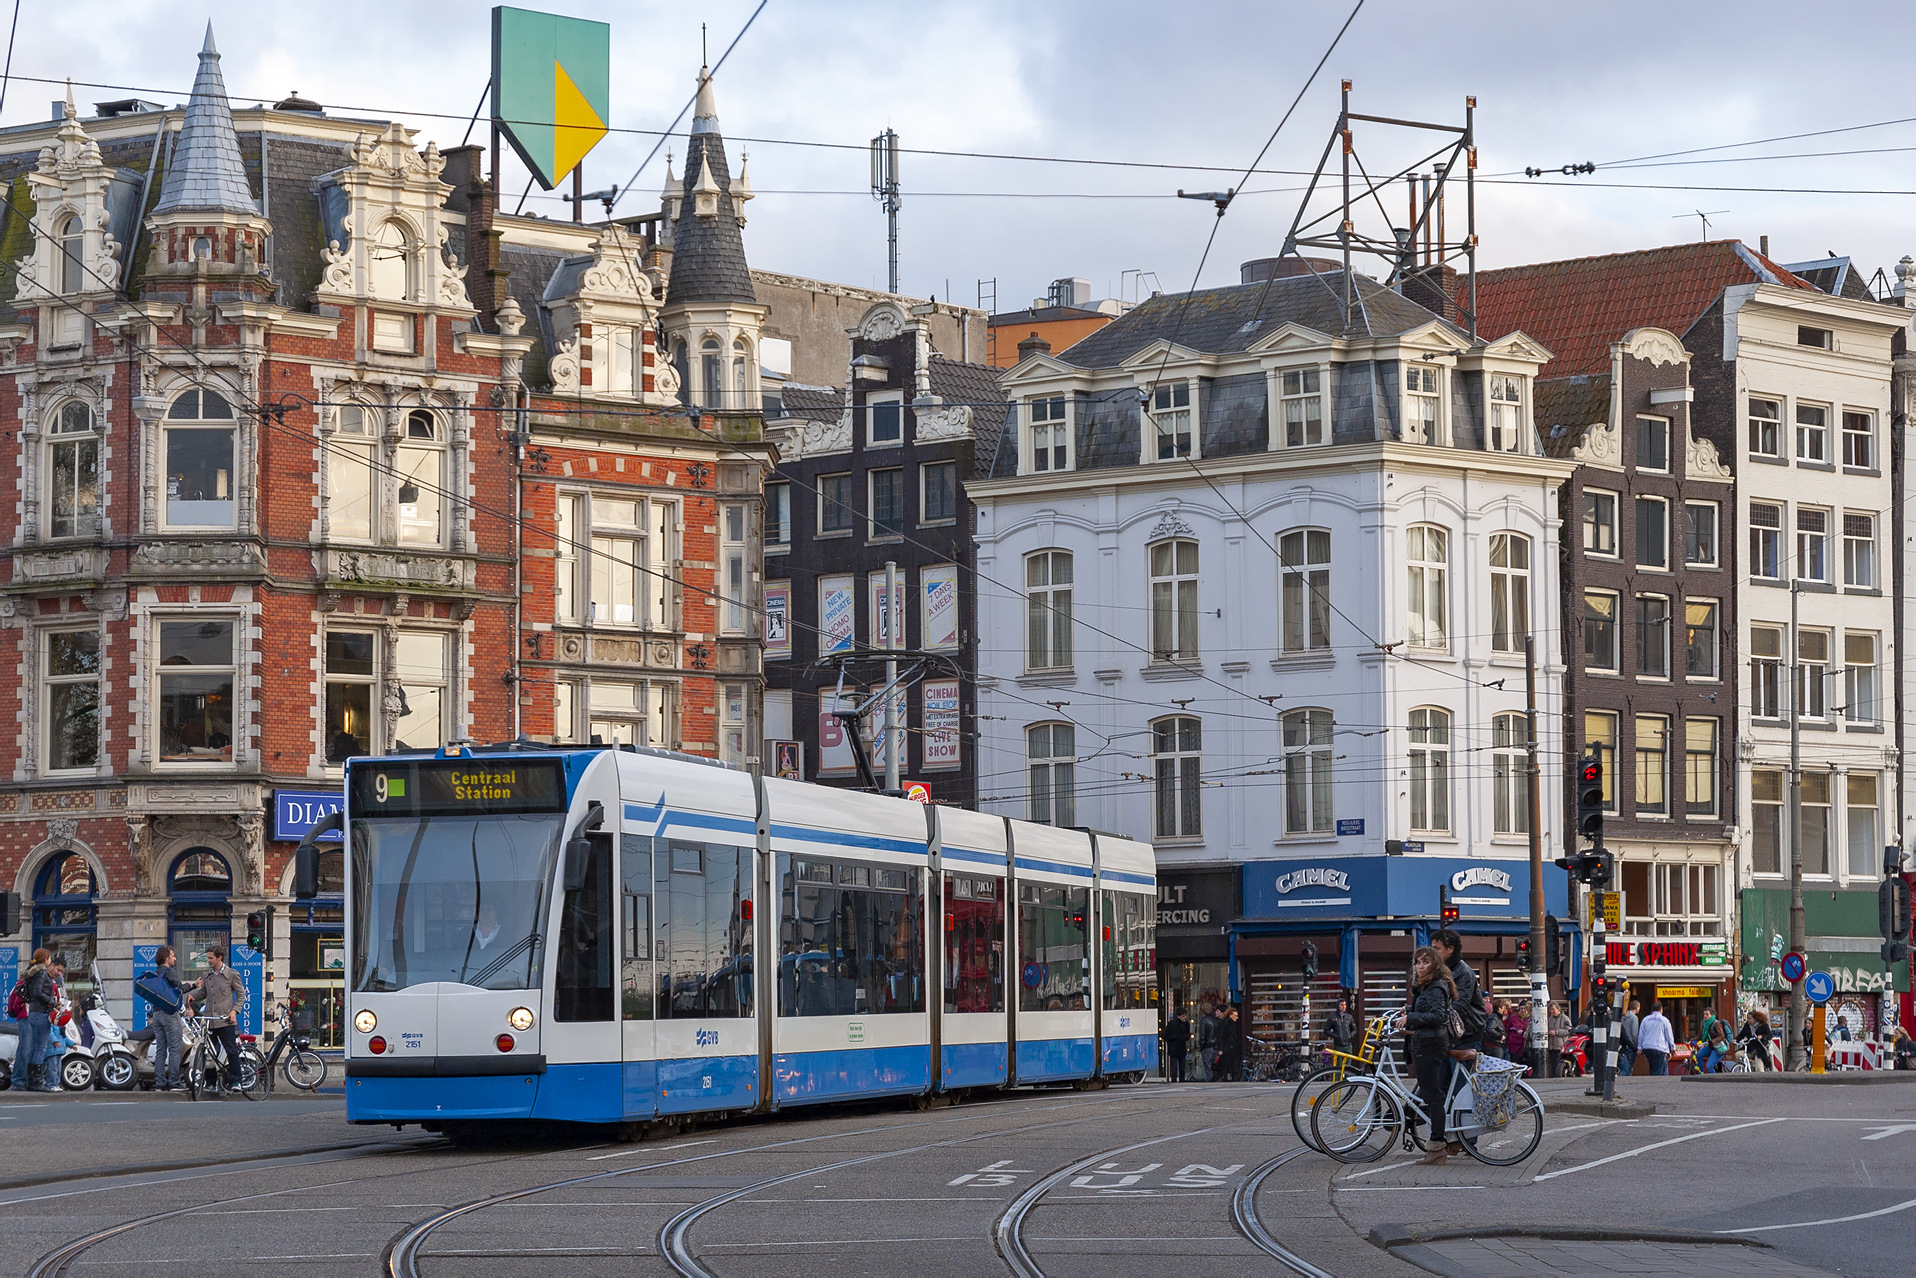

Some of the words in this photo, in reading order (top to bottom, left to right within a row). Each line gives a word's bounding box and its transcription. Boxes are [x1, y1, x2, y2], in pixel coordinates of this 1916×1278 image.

[827, 590, 844, 608] NEW
[934, 581, 952, 599] DAYS
[766, 599, 785, 607] CINEMA
[825, 596, 852, 622] PRIVATE
[933, 592, 954, 612] WEEK
[828, 614, 850, 634] HOMO
[825, 625, 852, 649] CINEMA
[926, 687, 958, 699] CINEMA
[943, 701, 957, 709] STOP
[933, 731, 951, 743] LIVE
[928, 745, 956, 757] SHOW
[451, 771, 516, 785] Centraal
[375, 773, 388, 803] 9
[455, 786, 511, 799] Station
[1276, 868, 1350, 894] CAMEL
[1452, 867, 1513, 892] CAMEL
[1606, 942, 1635, 965] NILE
[1642, 942, 1699, 966] SPHINX
[1662, 988, 1685, 996] shoarma
[243, 969, 251, 1035] DIAMONDS
[707, 1031, 719, 1045] GVB
